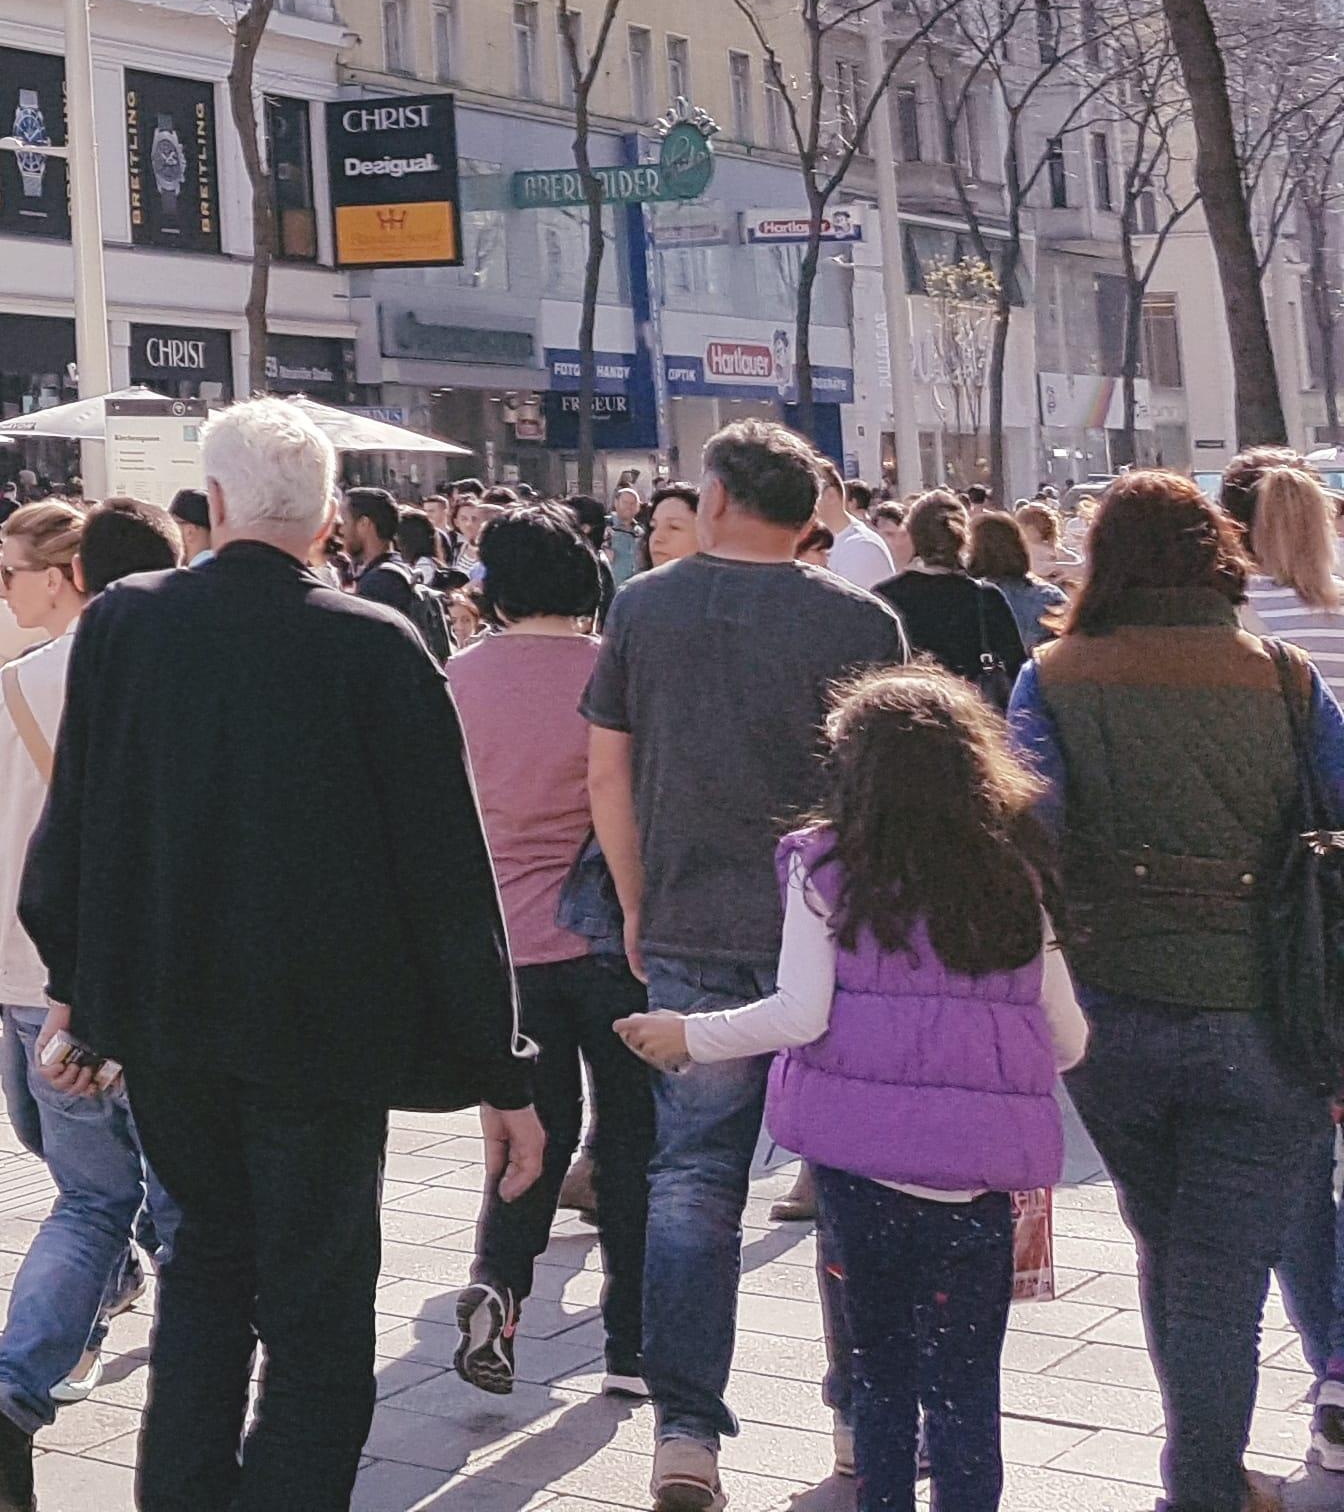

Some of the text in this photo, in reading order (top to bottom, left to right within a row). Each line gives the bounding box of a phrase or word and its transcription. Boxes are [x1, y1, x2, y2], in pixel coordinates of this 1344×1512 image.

[342, 105, 431, 133] CHRIST
[127, 91, 142, 225] BREITLING
[195, 102, 211, 233] BREITLING
[145, 337, 206, 369] CHRIST
[711, 343, 771, 377] Hartlauer
[553, 362, 581, 377] FOTO
[596, 365, 631, 380] HANDY
[667, 368, 697, 383] OPTIK
